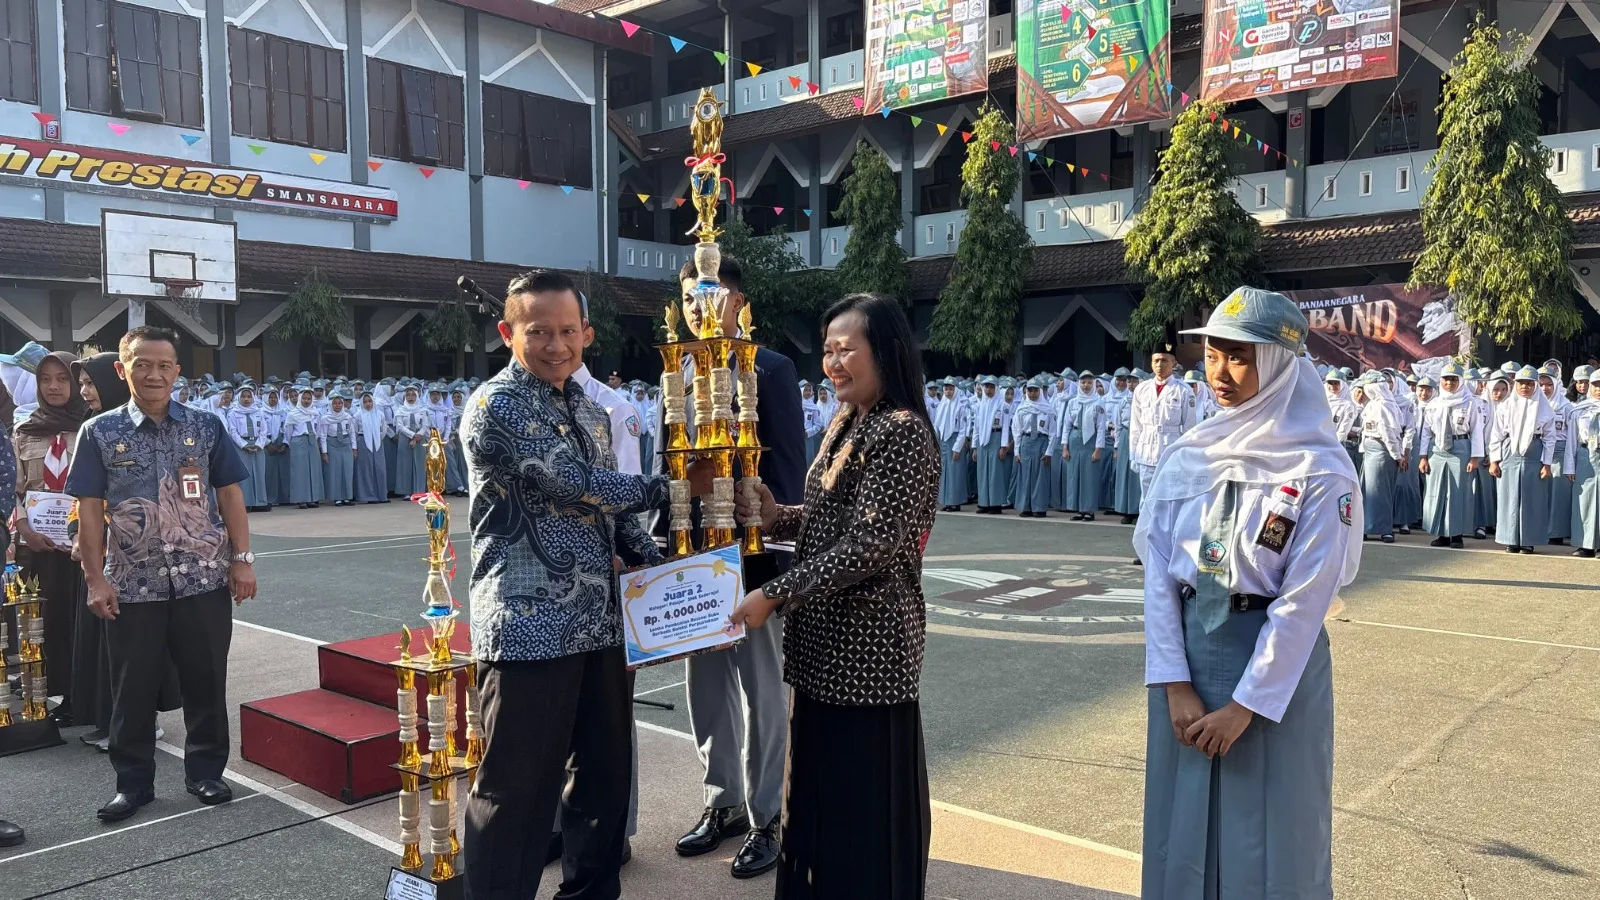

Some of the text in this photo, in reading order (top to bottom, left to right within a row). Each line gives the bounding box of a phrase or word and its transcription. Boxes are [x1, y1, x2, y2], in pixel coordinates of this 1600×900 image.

[1073, 15, 1082, 35] 4
[1261, 30, 1287, 39] Operation
[1099, 32, 1108, 53] 5
[1072, 63, 1081, 82] 6
[37, 149, 262, 199] Prestasi
[267, 187, 385, 211] SMANSABARA
[1299, 294, 1366, 310] BANJARNEGARA
[1309, 299, 1398, 344] BAND
[664, 588, 693, 601] Juara
[696, 584, 703, 594] 2
[644, 616, 661, 626] Rp.
